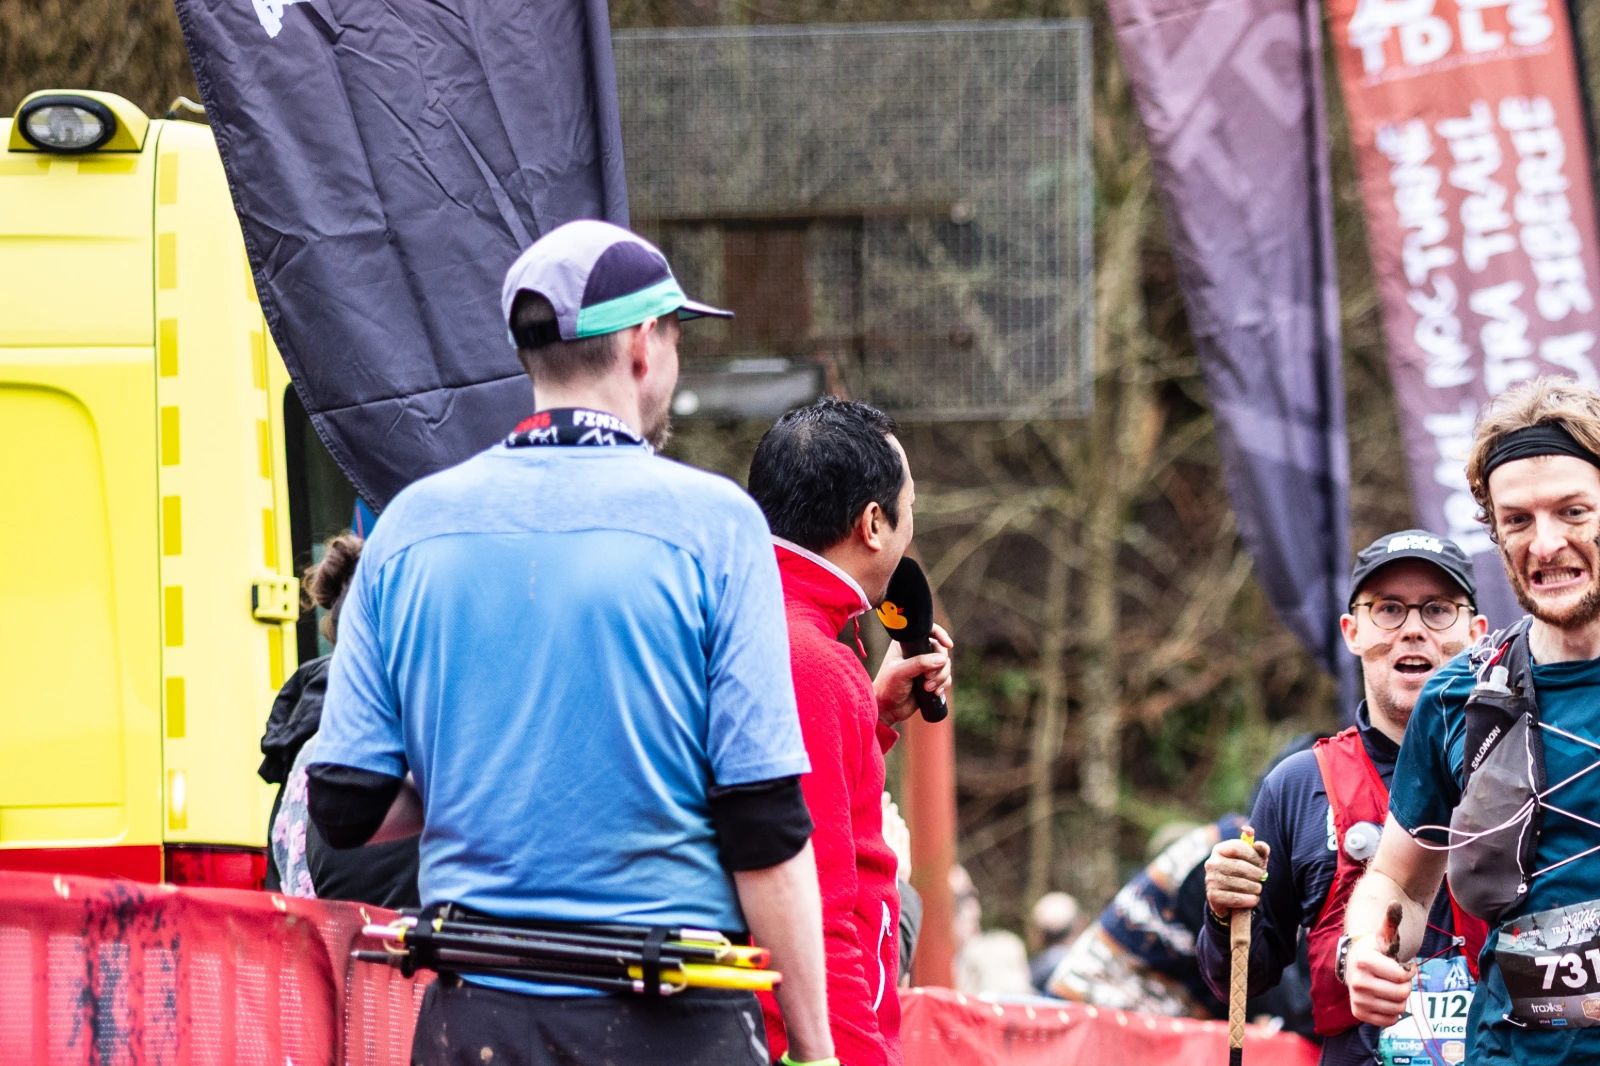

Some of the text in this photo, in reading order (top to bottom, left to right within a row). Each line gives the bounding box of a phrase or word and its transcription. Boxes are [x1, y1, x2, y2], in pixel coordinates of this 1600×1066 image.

[1349, 0, 1555, 76] TDLS
[1436, 104, 1518, 274] TRAIL
[1470, 726, 1502, 770] SALOMON
[1551, 924, 1573, 936] TRAIL
[1573, 920, 1597, 931] WITH
[1562, 908, 1597, 926] IN 2026
[1428, 995, 1467, 1018] 112
[1432, 1022, 1465, 1033] Vince
